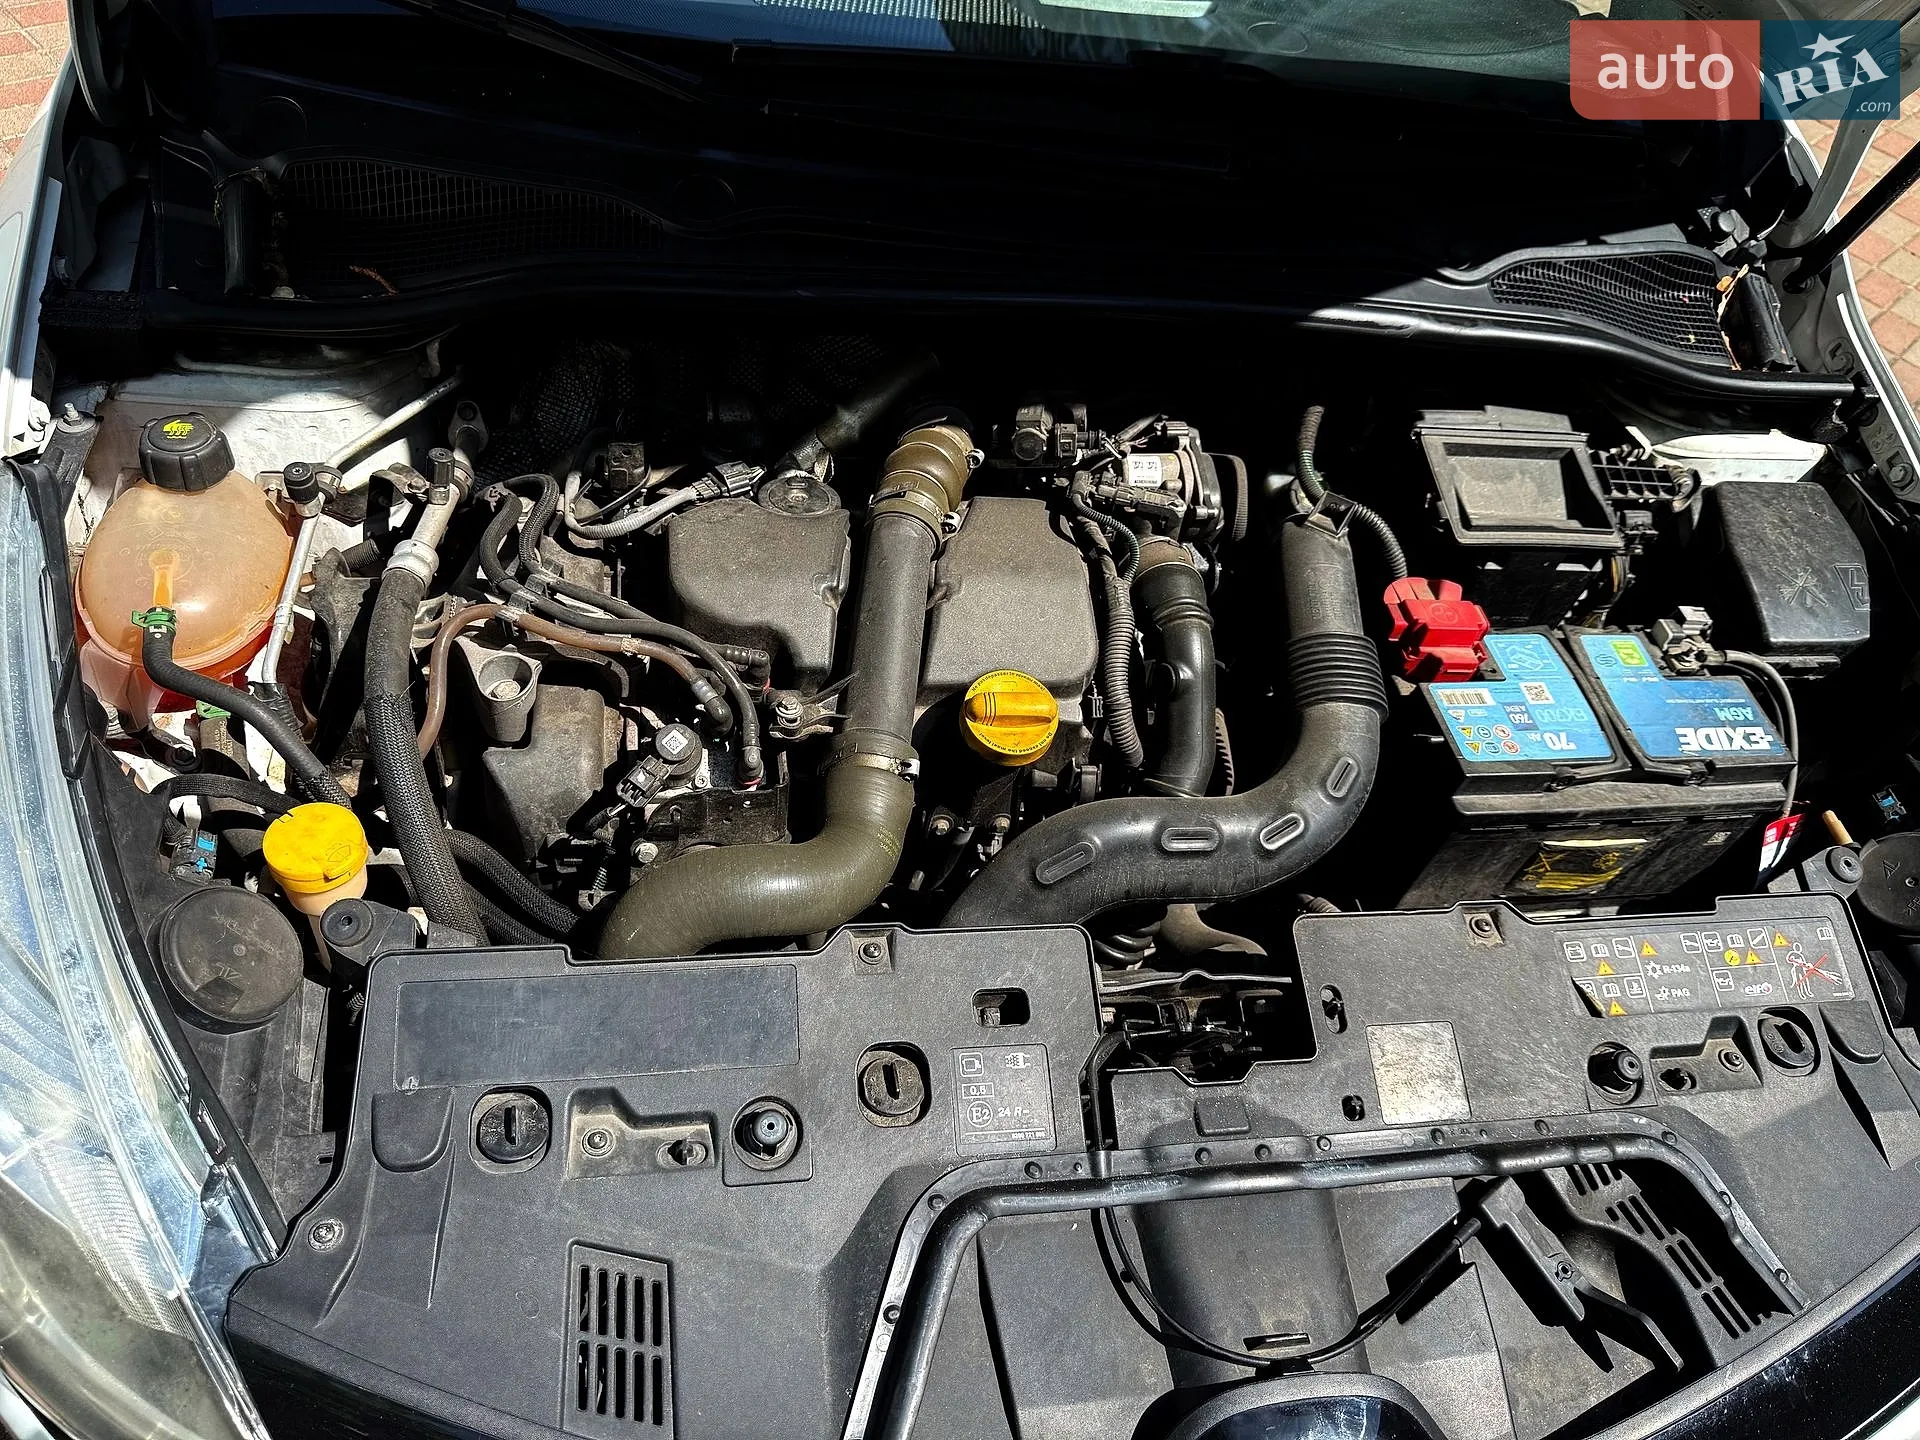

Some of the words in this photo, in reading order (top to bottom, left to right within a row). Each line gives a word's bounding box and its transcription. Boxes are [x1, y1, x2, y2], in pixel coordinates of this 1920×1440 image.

[1507, 712, 1534, 725] 760
[1713, 706, 1755, 721] AGM
[1541, 730, 1577, 751] 70
[1674, 727, 1775, 752] EXIDE
[1670, 987, 1691, 998] PAG
[970, 1106, 991, 1123] E2
[997, 1106, 1012, 1118] 24
